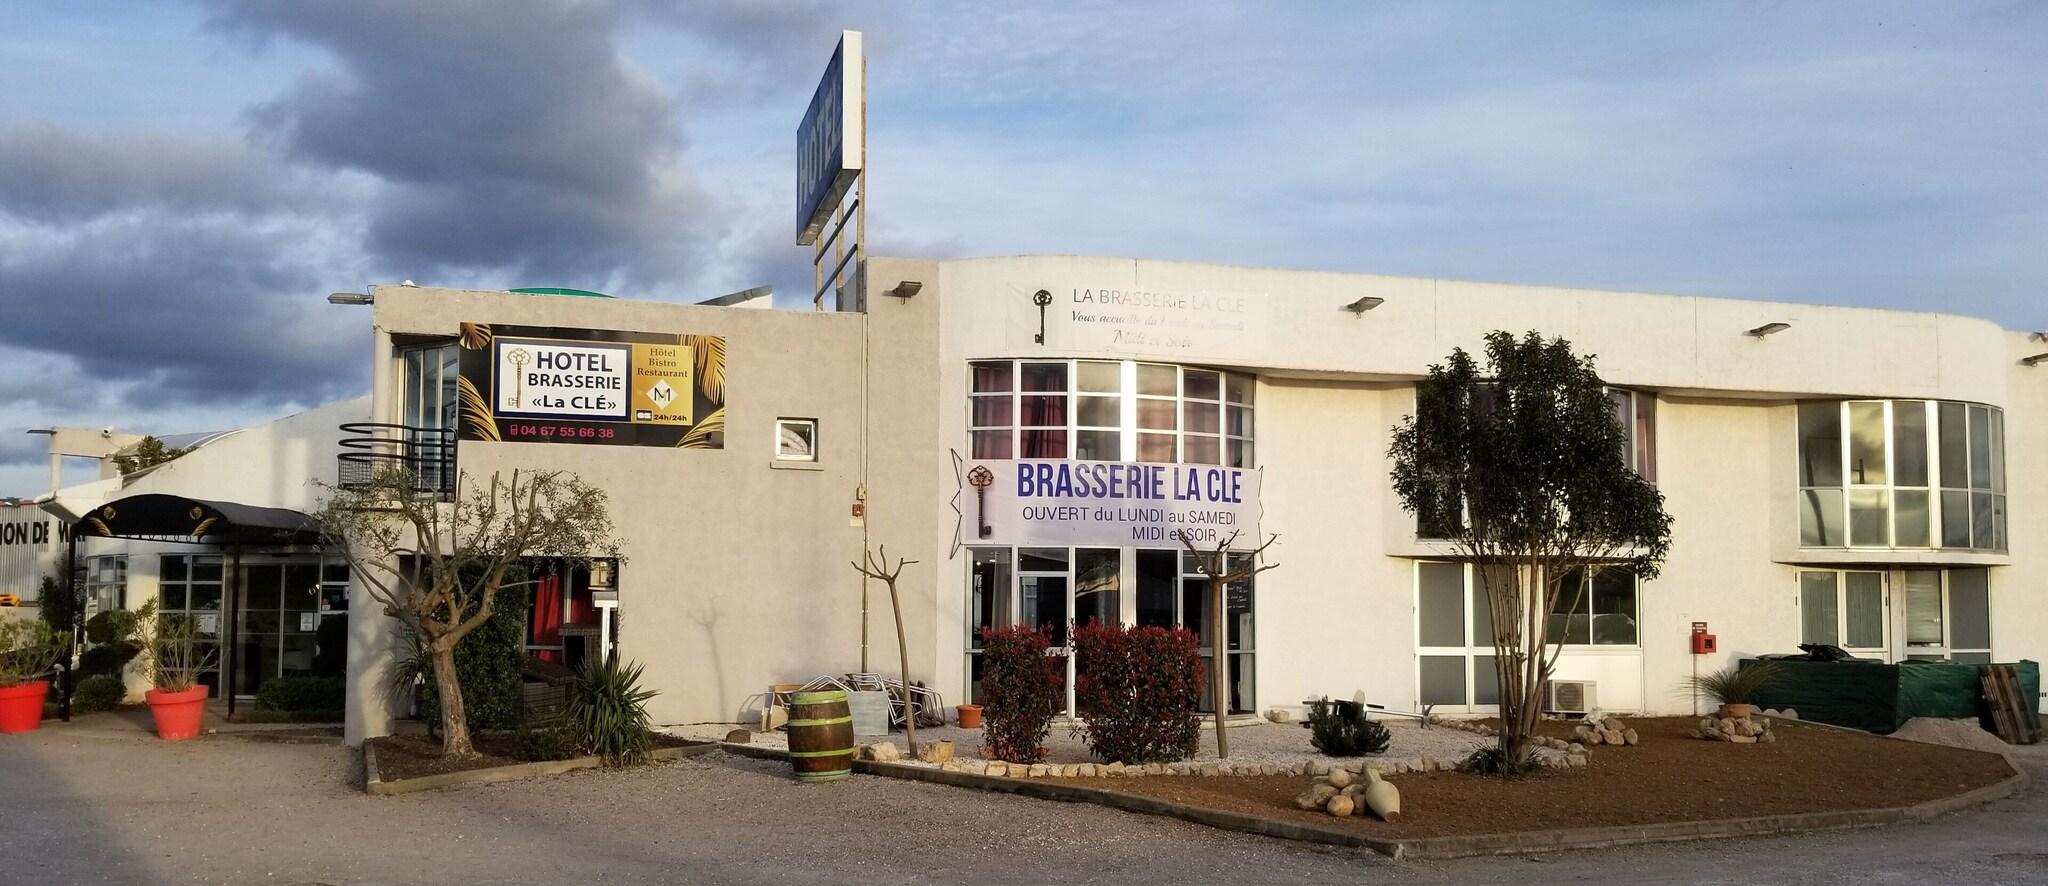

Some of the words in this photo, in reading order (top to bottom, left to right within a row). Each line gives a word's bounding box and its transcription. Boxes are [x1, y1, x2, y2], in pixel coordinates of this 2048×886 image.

[799, 80, 840, 212] HOTEL
[1073, 288, 1094, 303] LA
[1099, 289, 1186, 309] BRASSERIE
[1192, 294, 1211, 311] LA
[1072, 310, 1096, 322] Vous
[650, 347, 676, 357] Hôtel
[537, 351, 613, 372] HOTEL
[649, 358, 677, 367] Bistro
[637, 367, 688, 378] Restaurant
[528, 373, 621, 389] BRASSERIE
[653, 414, 688, 422] 24h/24h
[520, 425, 537, 436] 04
[540, 426, 557, 437] 67
[560, 427, 576, 437] 55
[579, 428, 595, 438] 66
[598, 428, 614, 439] 38
[1017, 463, 1166, 500] BRASSERIE
[1173, 467, 1201, 501] LA
[1207, 469, 1242, 503] CLE
[1022, 506, 1090, 521] OUVERT
[1094, 507, 1113, 521] du
[1118, 507, 1164, 523] LUNDI
[1168, 512, 1185, 523] au
[1188, 510, 1236, 525] SAMEDI
[32, 521, 50, 544] DE
[1132, 526, 1165, 541] MIDI
[1186, 527, 1217, 542] SOIR
